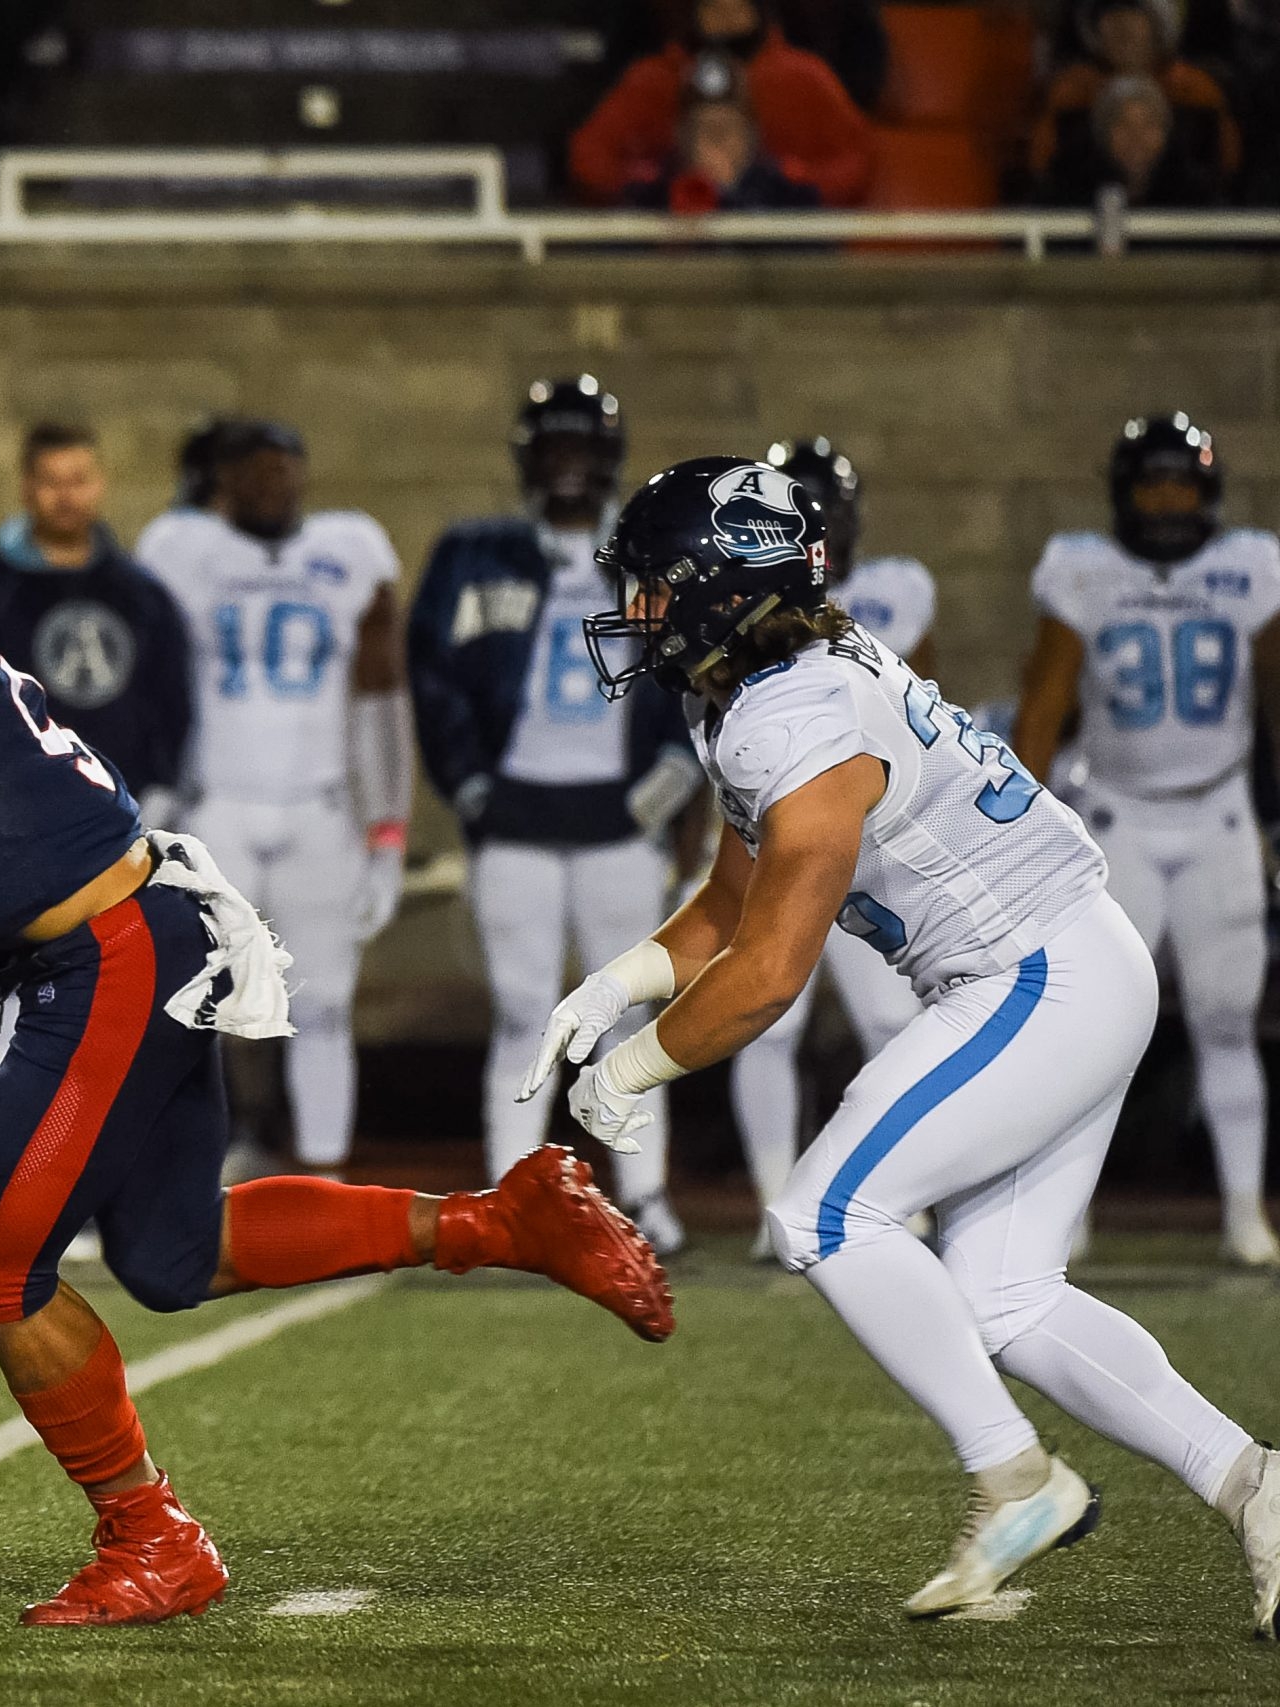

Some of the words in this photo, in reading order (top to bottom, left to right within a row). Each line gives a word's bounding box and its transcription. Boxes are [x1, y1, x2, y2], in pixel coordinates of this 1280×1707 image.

[733, 471, 764, 496] A
[811, 566, 824, 586] 36
[53, 617, 116, 689] A
[215, 602, 335, 699] 10
[1094, 620, 1237, 730] 38
